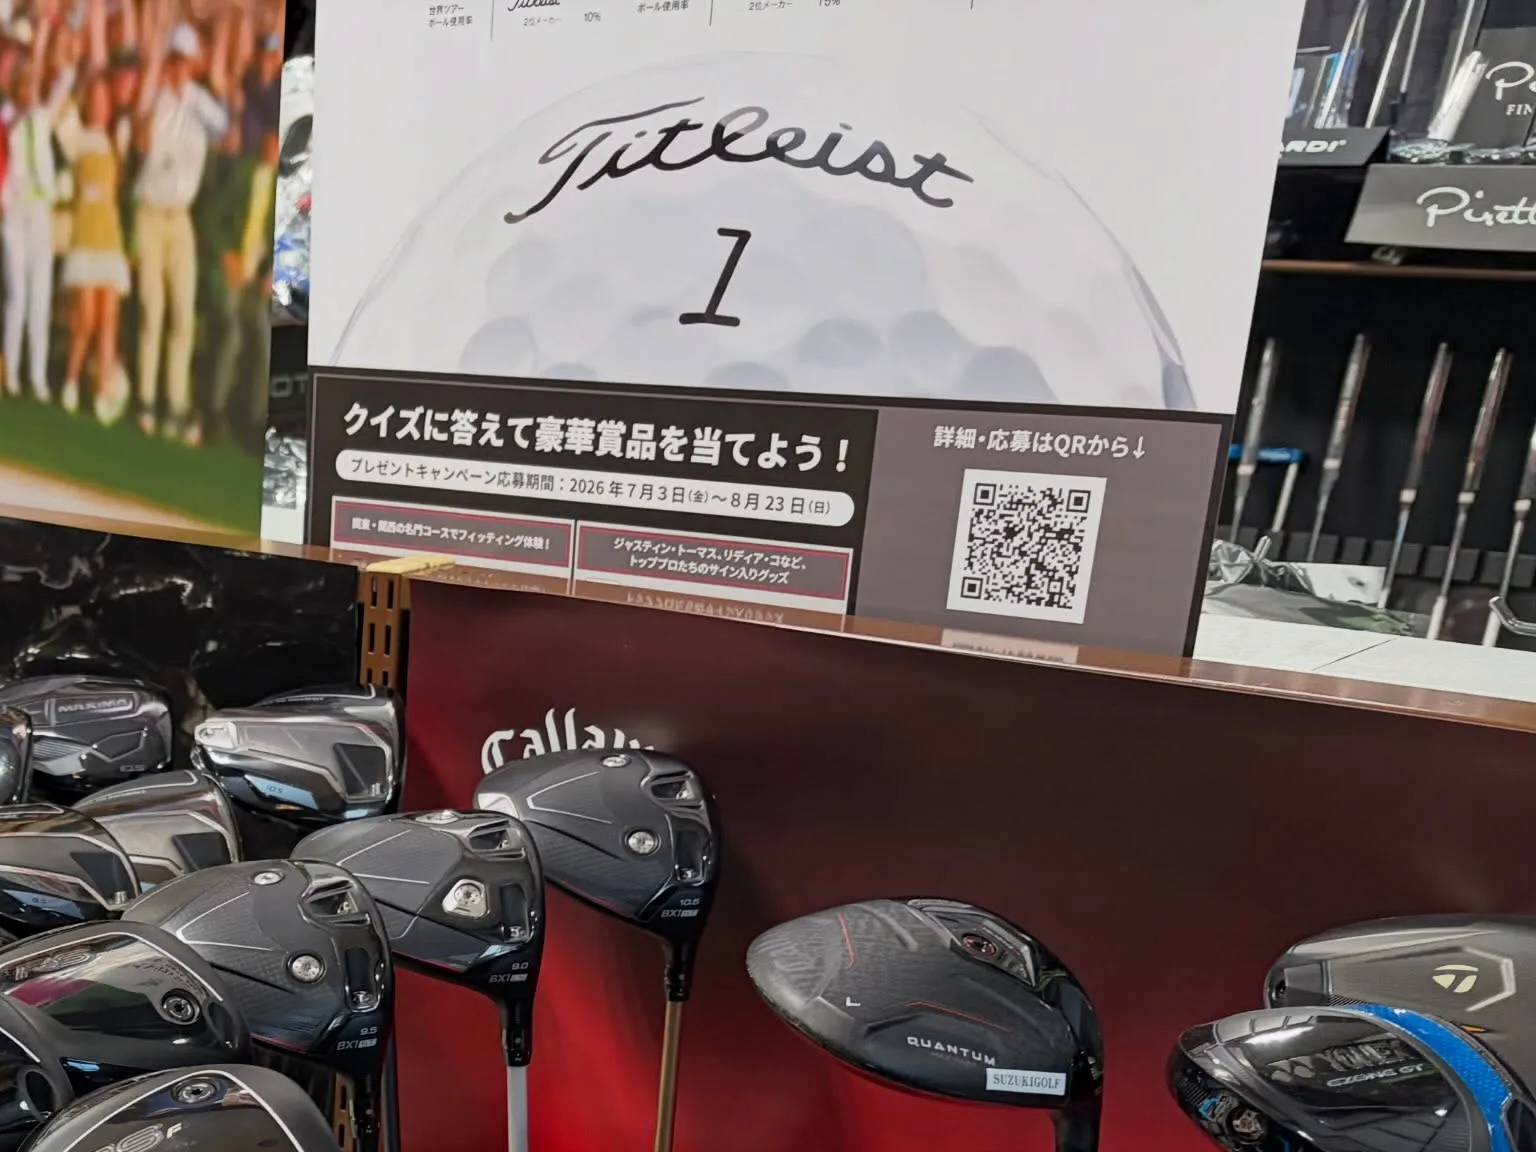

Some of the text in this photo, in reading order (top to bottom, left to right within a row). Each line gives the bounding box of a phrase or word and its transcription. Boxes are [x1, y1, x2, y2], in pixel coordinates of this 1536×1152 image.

[504, 96, 973, 224] Titleist
[679, 228, 752, 326] 1
[343, 402, 850, 473] クイズに答えて豪華賞品を当てよう！
[907, 1035, 996, 1066] QUANTUM
[993, 1073, 1062, 1090] SUZUKIGOLF
